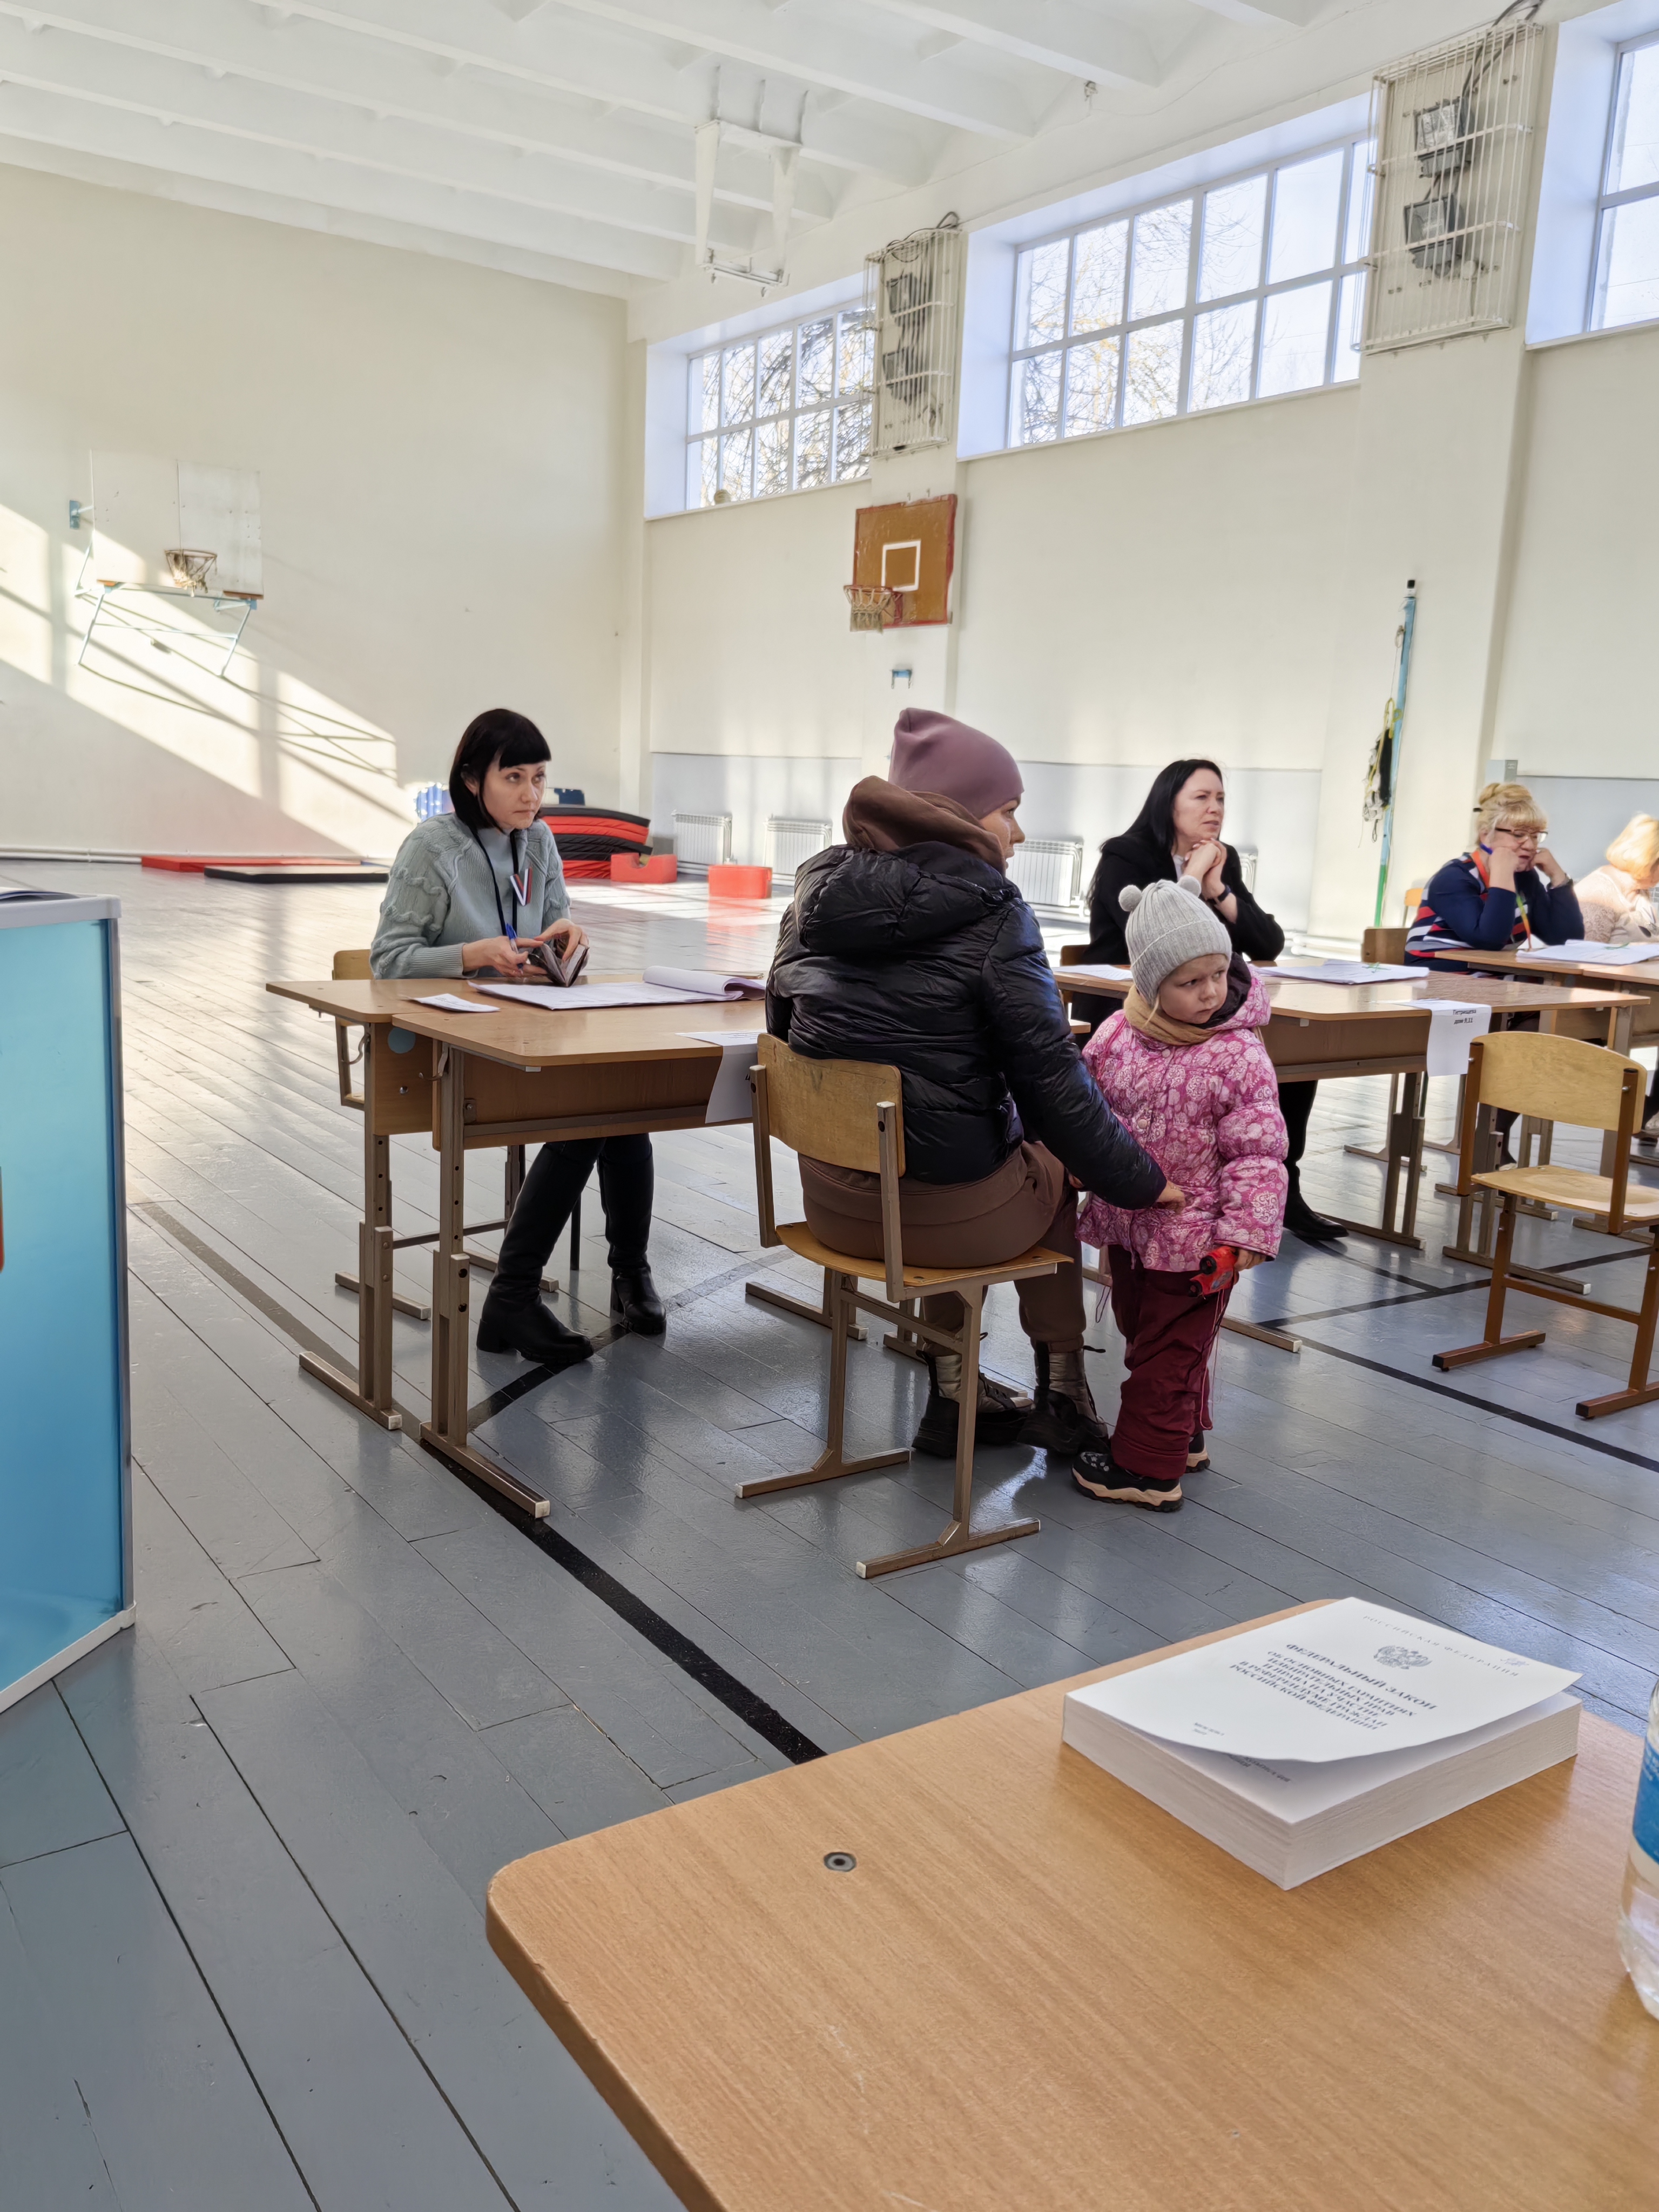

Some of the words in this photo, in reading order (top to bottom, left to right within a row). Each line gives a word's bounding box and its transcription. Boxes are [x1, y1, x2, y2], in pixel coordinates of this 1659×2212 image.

[1284, 1657, 1348, 1686] ОСНОВНЫХ
[1286, 1644, 1386, 1688] ФЕДЕРАЛЬНЫЙ
[1385, 1686, 1438, 1709] ЗАКОН
